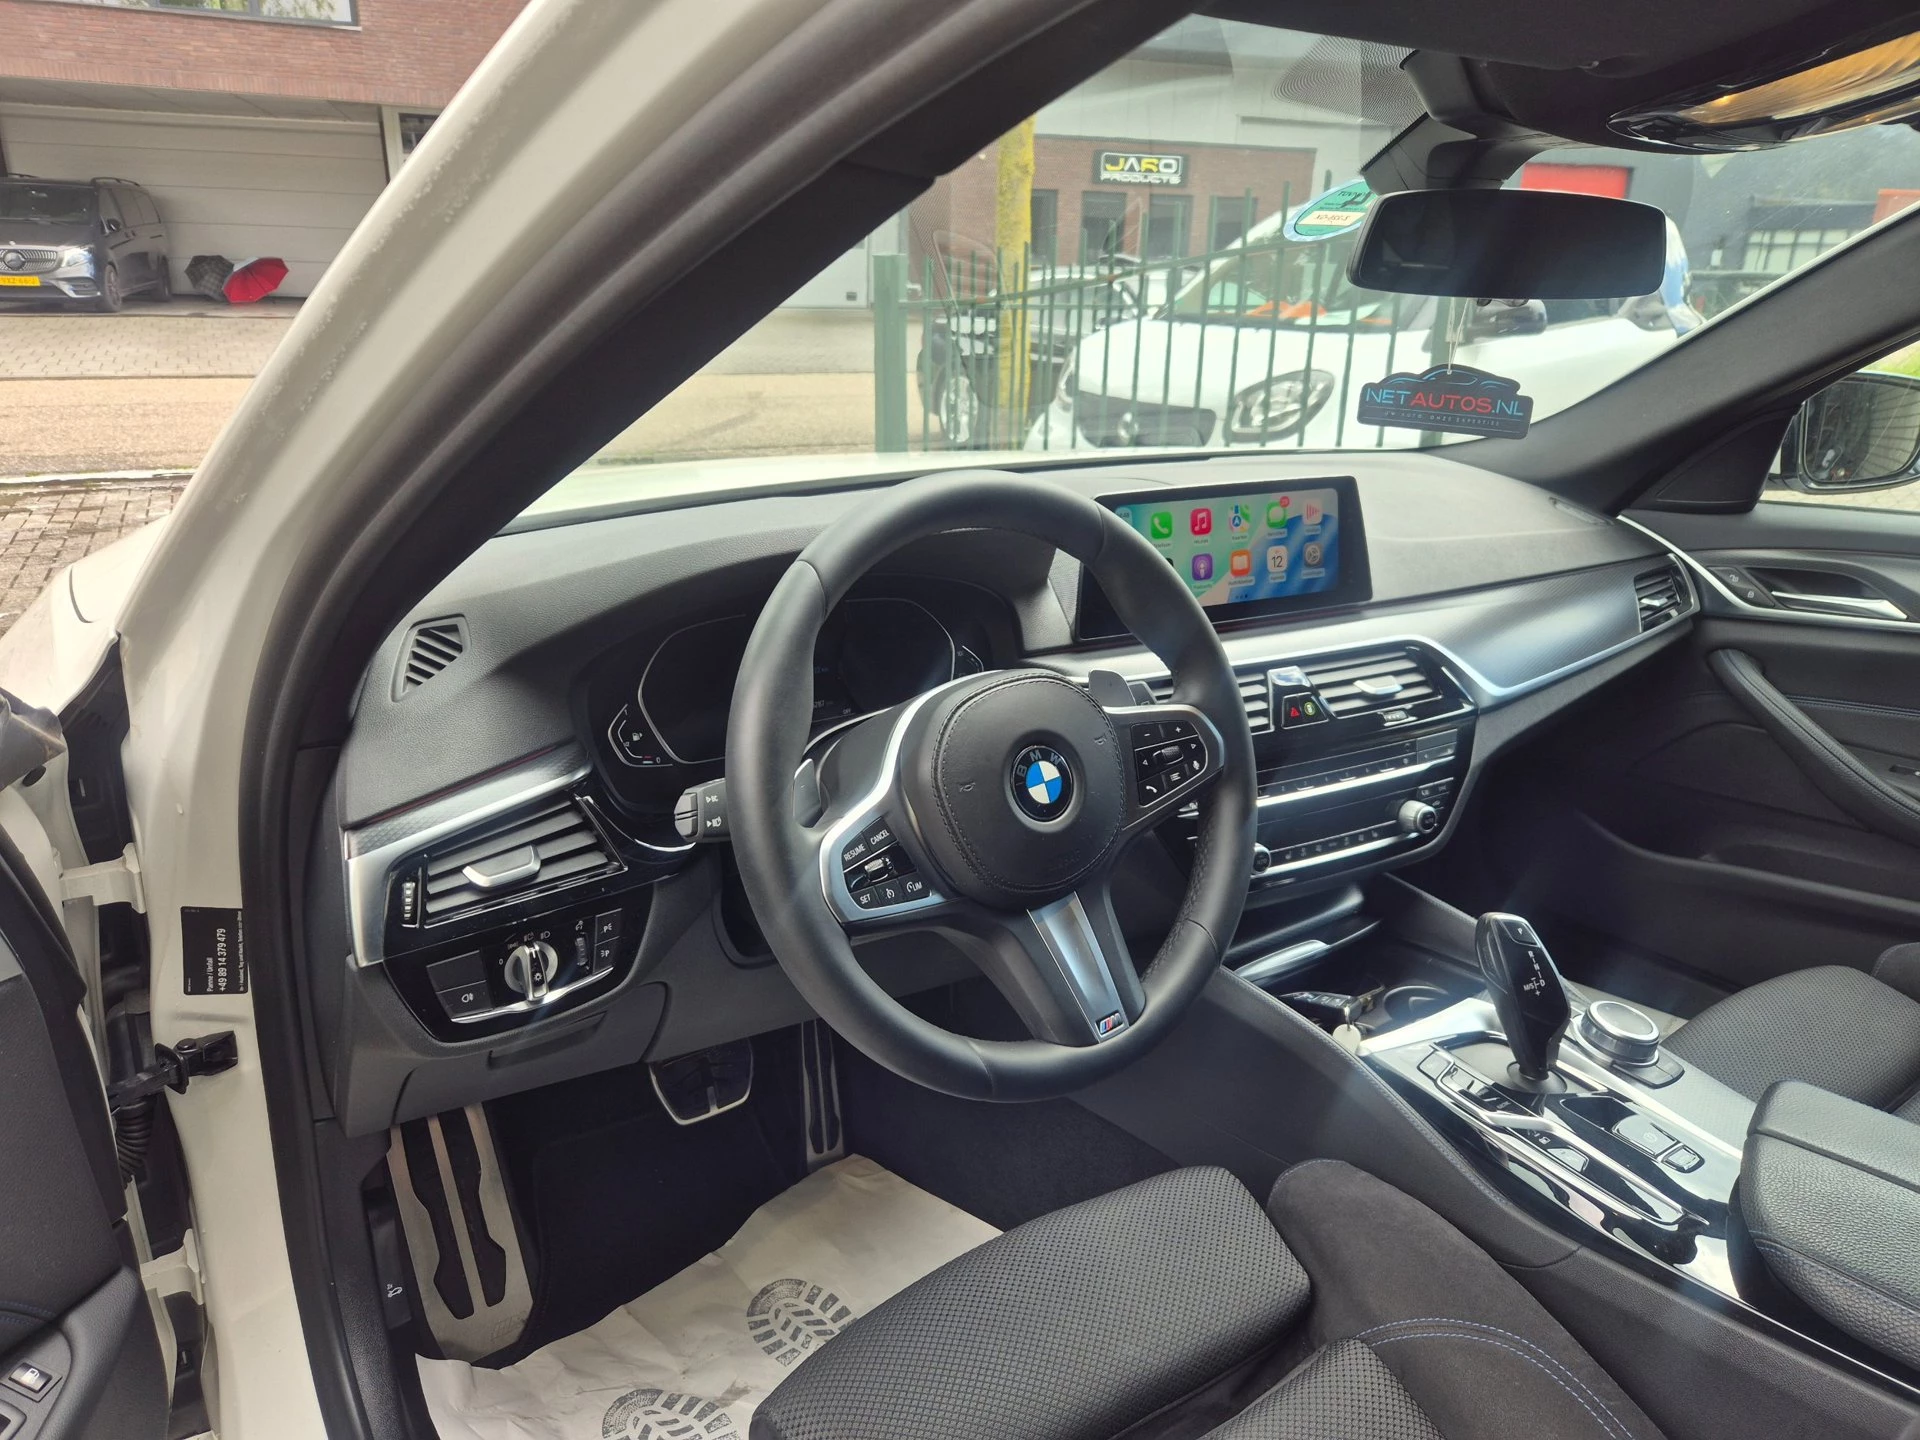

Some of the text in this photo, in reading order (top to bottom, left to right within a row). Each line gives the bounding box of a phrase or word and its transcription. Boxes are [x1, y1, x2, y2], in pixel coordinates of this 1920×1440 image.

[1105, 157, 1178, 173] JARO
[1100, 173, 1181, 184] PRODUCTS
[1272, 555, 1283, 568] 12
[1016, 749, 1062, 778] BMW
[843, 829, 890, 862] RESUME CANCEL
[859, 881, 923, 905] SET LIM
[206, 957, 214, 973] Unfall
[216, 928, 227, 992] +49 89 14 379 479
[206, 975, 214, 992] Panne
